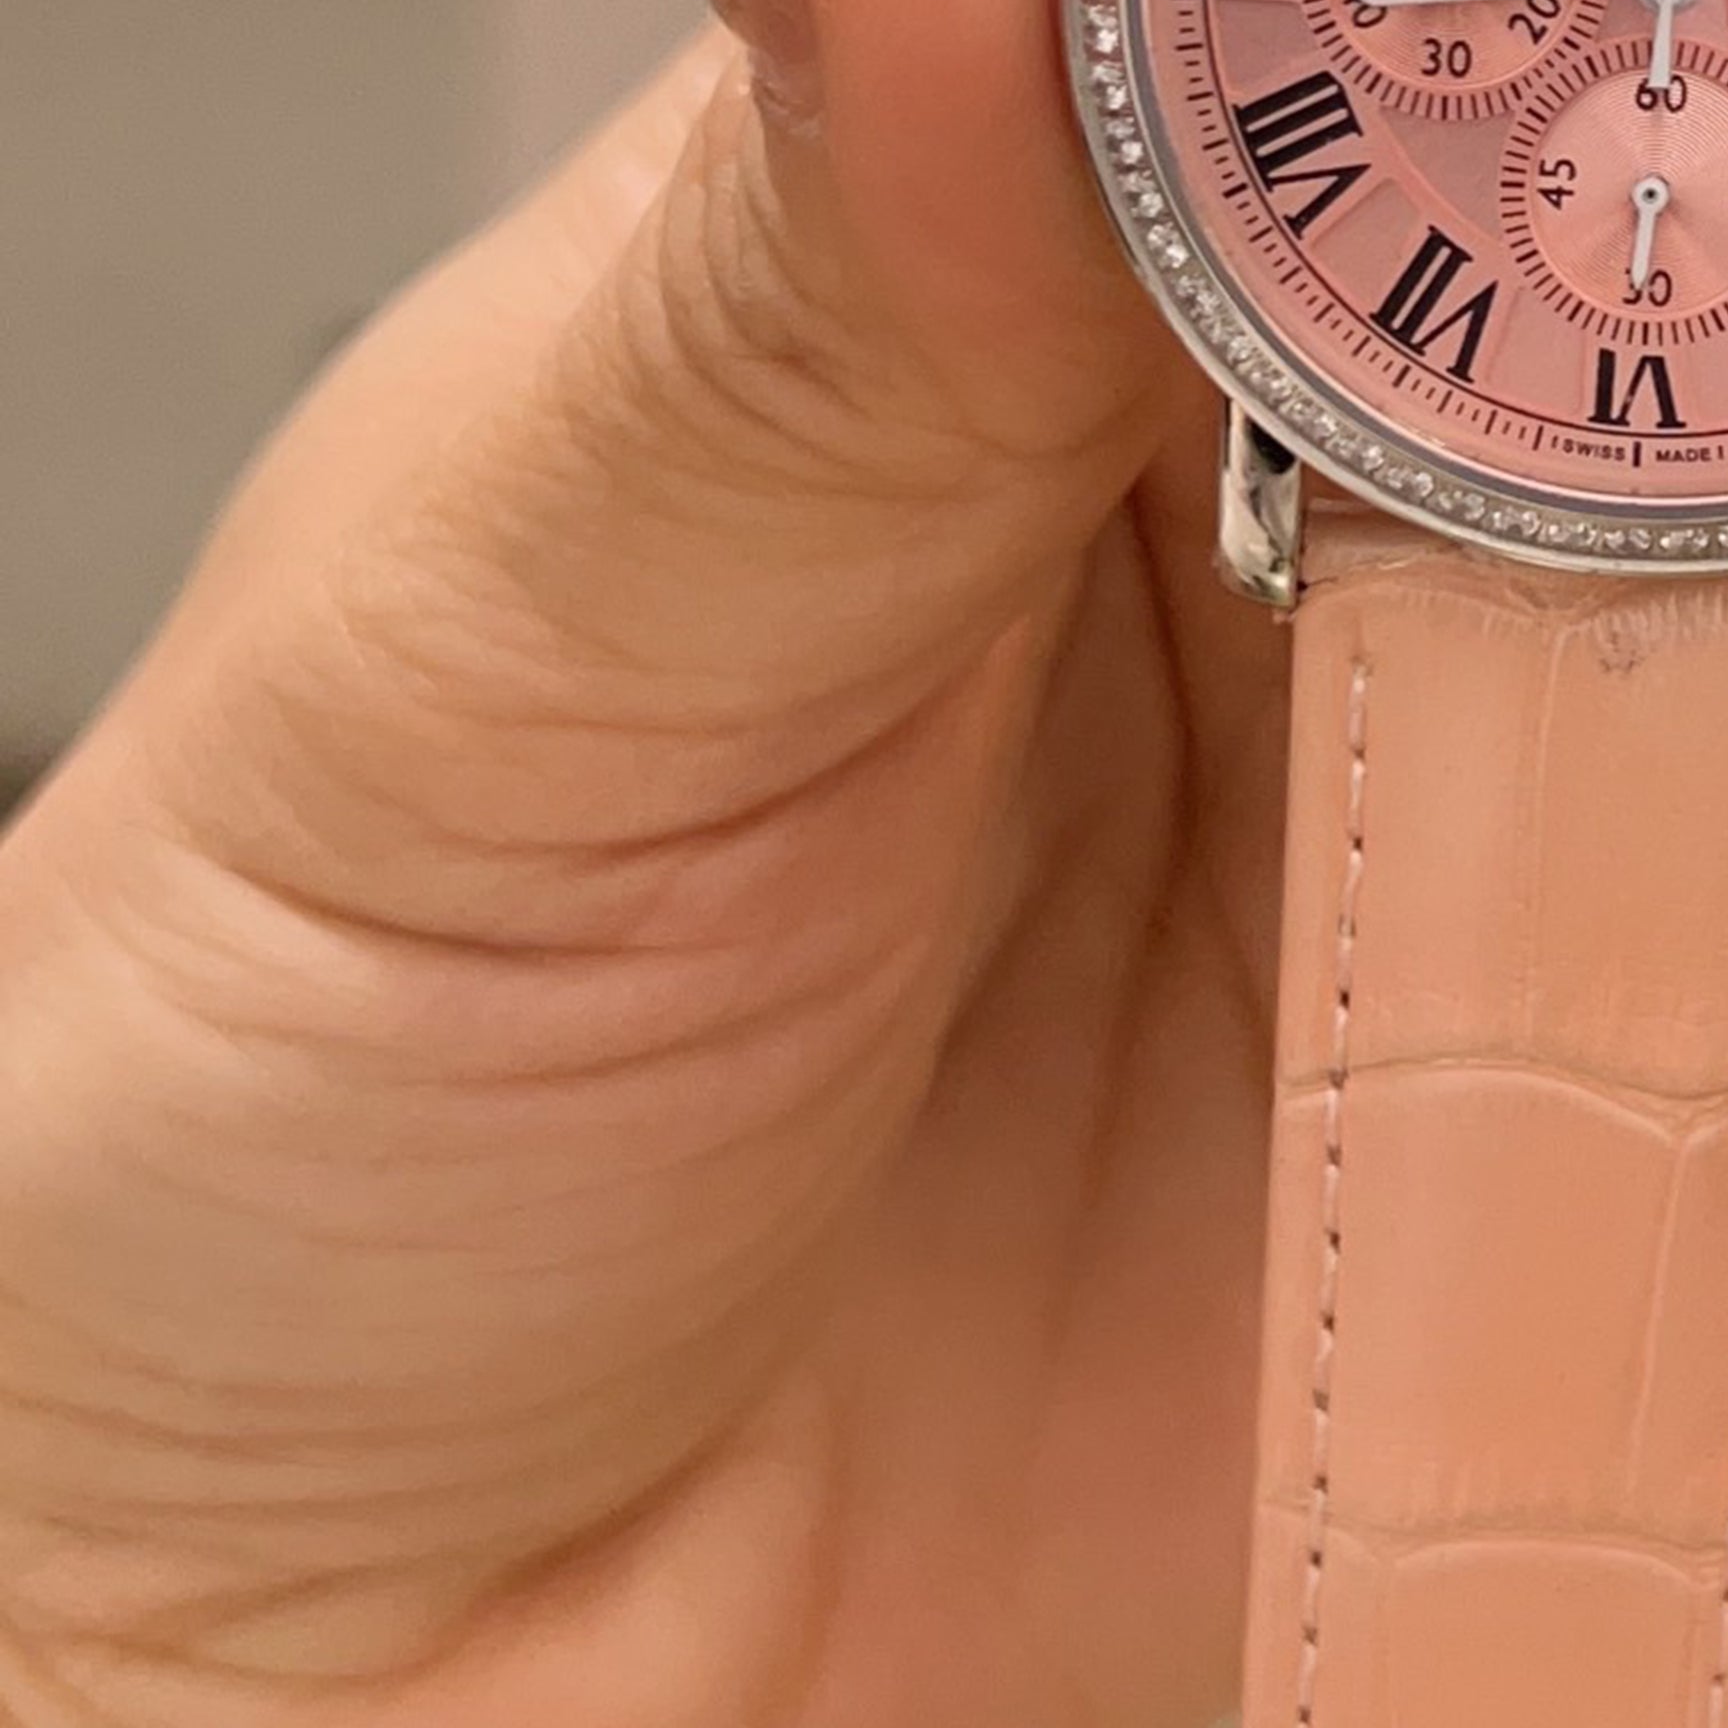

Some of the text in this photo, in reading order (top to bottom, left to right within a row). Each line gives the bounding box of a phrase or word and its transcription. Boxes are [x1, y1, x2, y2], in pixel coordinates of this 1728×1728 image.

[1421, 38, 1472, 78] 30
[1635, 75, 1687, 113] 60
[1232, 70, 1372, 240] VIII
[1538, 158, 1577, 210] 45
[1369, 225, 1498, 384] VII
[1622, 269, 1673, 307] 30
[1587, 347, 1687, 429] VI
[1562, 438, 1712, 463] SWISS MADE
